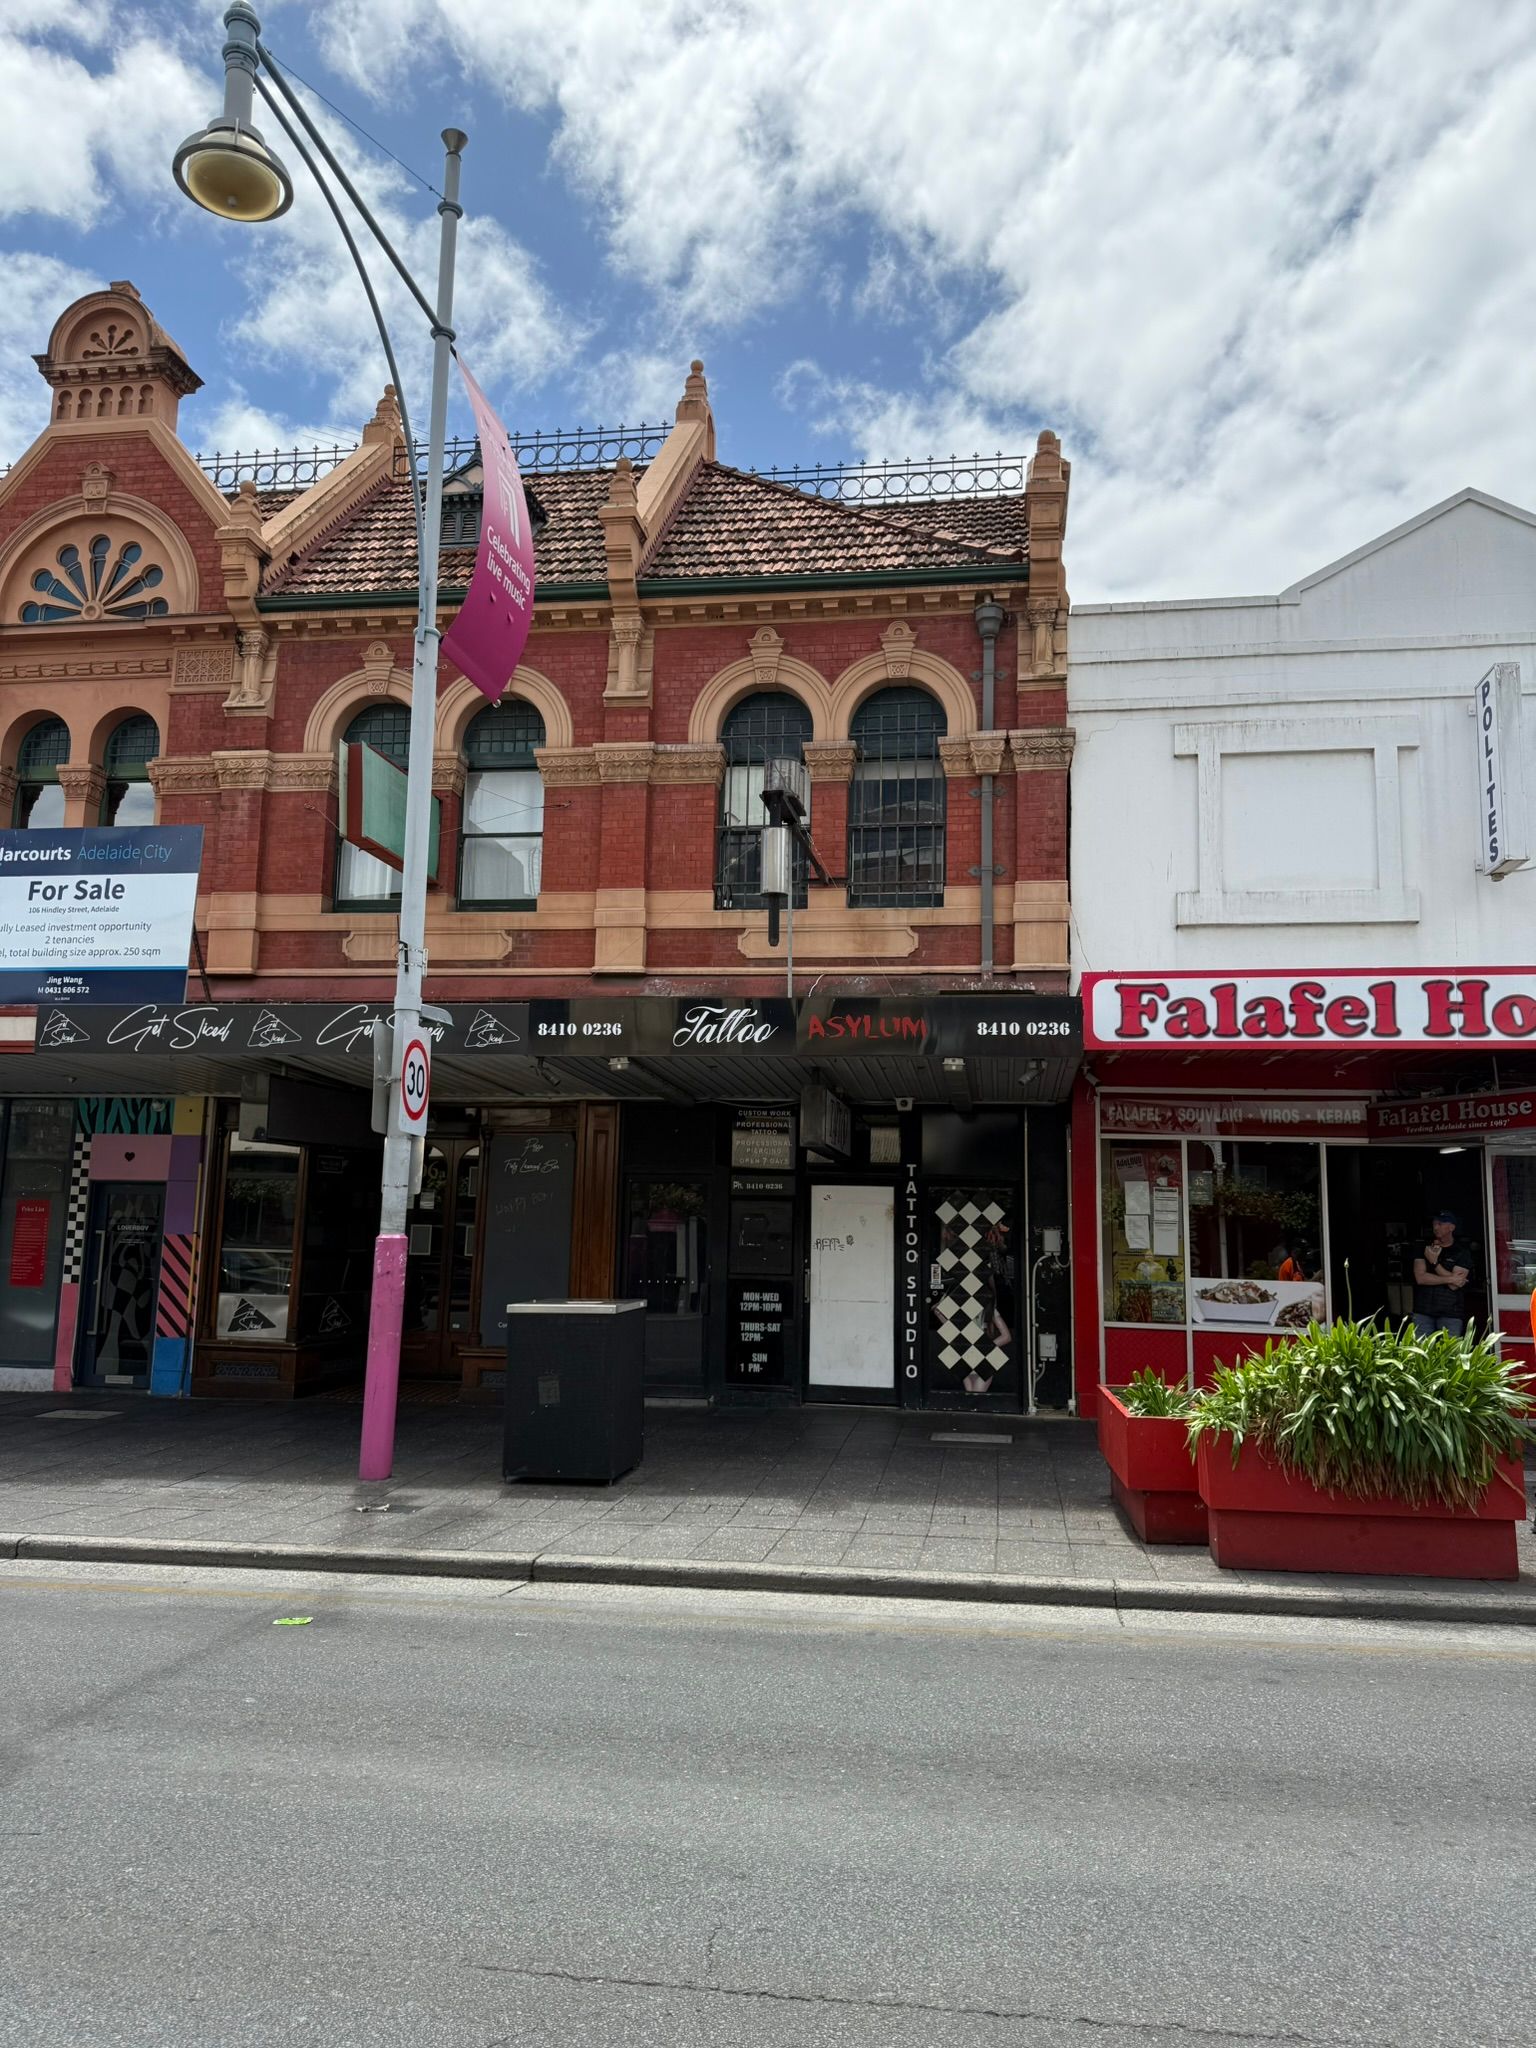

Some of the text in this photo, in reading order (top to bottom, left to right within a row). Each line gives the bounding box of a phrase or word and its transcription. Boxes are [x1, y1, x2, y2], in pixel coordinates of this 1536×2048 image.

[487, 525, 531, 595] Celebrating
[487, 550, 526, 611] live music
[1481, 680, 1498, 863] POLITES
[77, 844, 140, 861] Adelaide
[143, 844, 173, 863] City
[28, 878, 126, 901] For Sale
[28, 904, 120, 915] 106 Hindley Street, Adelaide
[0, 921, 152, 934] ully Leased investment opportunity
[44, 935, 95, 945] 2 tenancies
[9, 949, 31, 957] total
[31, 948, 68, 959] building
[69, 948, 87, 957] size
[88, 948, 122, 959] approx.
[123, 947, 140, 956] 250
[141, 949, 161, 959] sqm
[46, 976, 83, 985] Jing Wang
[44, 986, 62, 994] 0431
[62, 986, 76, 994] 606
[76, 986, 90, 994] 572
[1113, 979, 1536, 1039] Falafel Ho
[107, 1004, 234, 1052] Get Sliced
[316, 1004, 382, 1052] Get
[537, 1022, 622, 1036] 8410 0236
[672, 1006, 779, 1048] Tattoo
[808, 1014, 928, 1041] ASYLUM
[976, 1021, 1070, 1036] 8410 0236
[407, 1061, 425, 1098] 30
[737, 1109, 791, 1117] CUSTOM WORK
[1107, 1106, 1161, 1122] FALAFEL
[1317, 1108, 1361, 1124] KEBAB
[1377, 1099, 1533, 1127] Falafel House
[1434, 1123, 1466, 1132] Adelaide
[1468, 1121, 1488, 1129] since
[762, 1157, 767, 1166] 7
[905, 1163, 918, 1264] TATTOO
[742, 1292, 780, 1302] MON-WED
[739, 1302, 782, 1312] 12PM-10PM
[740, 1322, 781, 1332] THURS-SAT
[905, 1276, 918, 1378] STUDIO
[752, 1352, 768, 1363] SUN
[739, 1362, 745, 1373] 1
